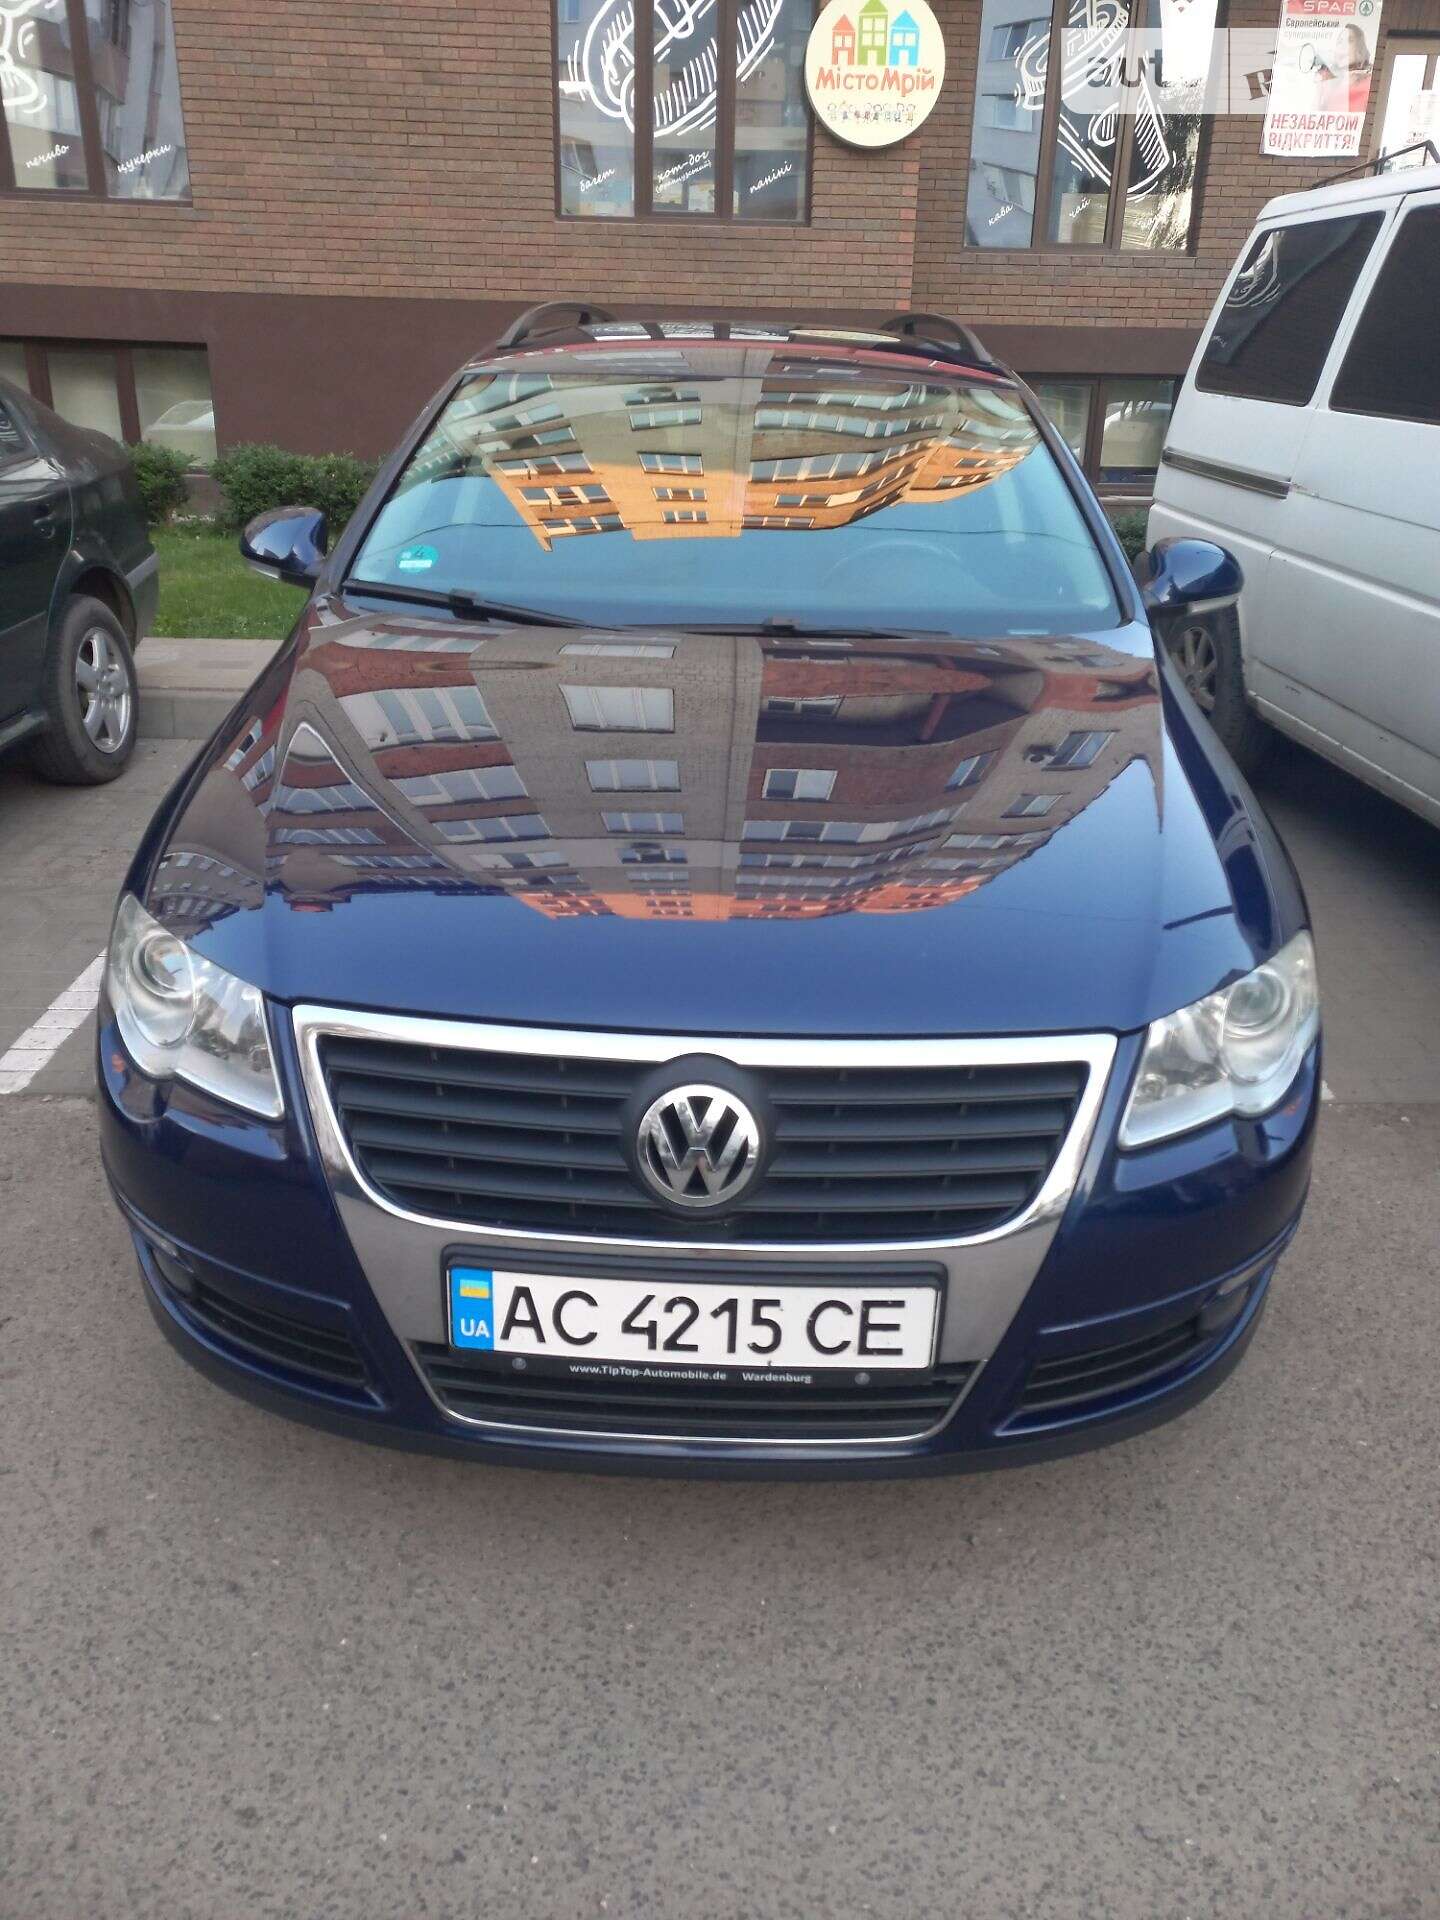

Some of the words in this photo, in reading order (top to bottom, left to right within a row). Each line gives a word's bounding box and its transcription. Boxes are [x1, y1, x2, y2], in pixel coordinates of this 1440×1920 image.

[1303, 0, 1355, 13] SPAR
[1285, 17, 1340, 28] Європейський
[1270, 113, 1359, 131] НЕЗАБАРОМ
[1269, 132, 1356, 150] ВІДКРИТТЯ!
[25, 144, 70, 169] печиво
[117, 143, 172, 174] цукерки
[657, 150, 710, 183] хот-дог
[579, 168, 616, 192] багет
[749, 160, 793, 194] паніні
[460, 1317, 490, 1338] UA
[499, 1285, 599, 1346] AC
[621, 1293, 783, 1354] 4215
[807, 1300, 906, 1356] CE
[569, 1363, 727, 1381] www.TipTop-Automobile.de
[742, 1371, 814, 1385] Wardenburg
